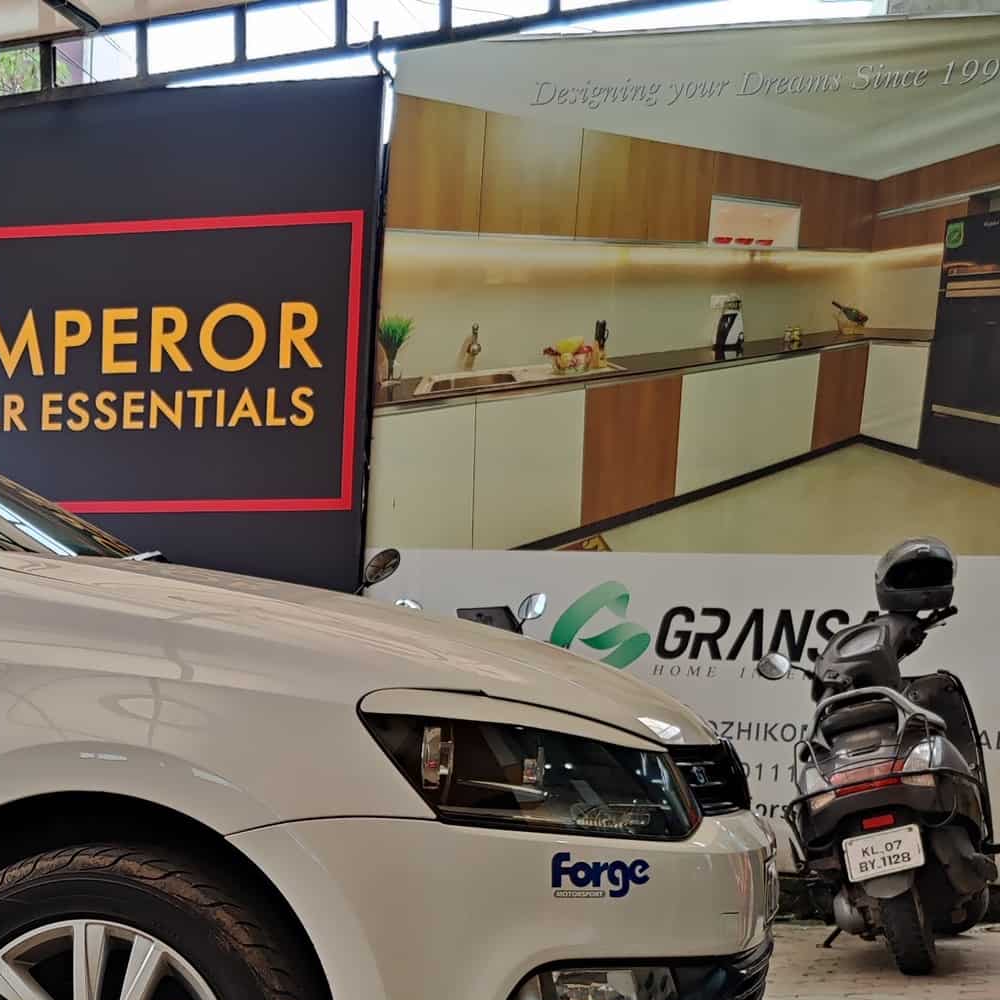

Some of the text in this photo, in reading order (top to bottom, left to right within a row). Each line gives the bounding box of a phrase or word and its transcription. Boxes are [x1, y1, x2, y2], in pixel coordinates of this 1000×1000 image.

[530, 76, 662, 110] Designing
[667, 79, 730, 106] your
[736, 71, 842, 97] Dreams
[851, 63, 929, 91] Since
[41, 386, 316, 432] ESSENTIALS
[655, 606, 880, 662] GRANS
[651, 664, 719, 678] HOME
